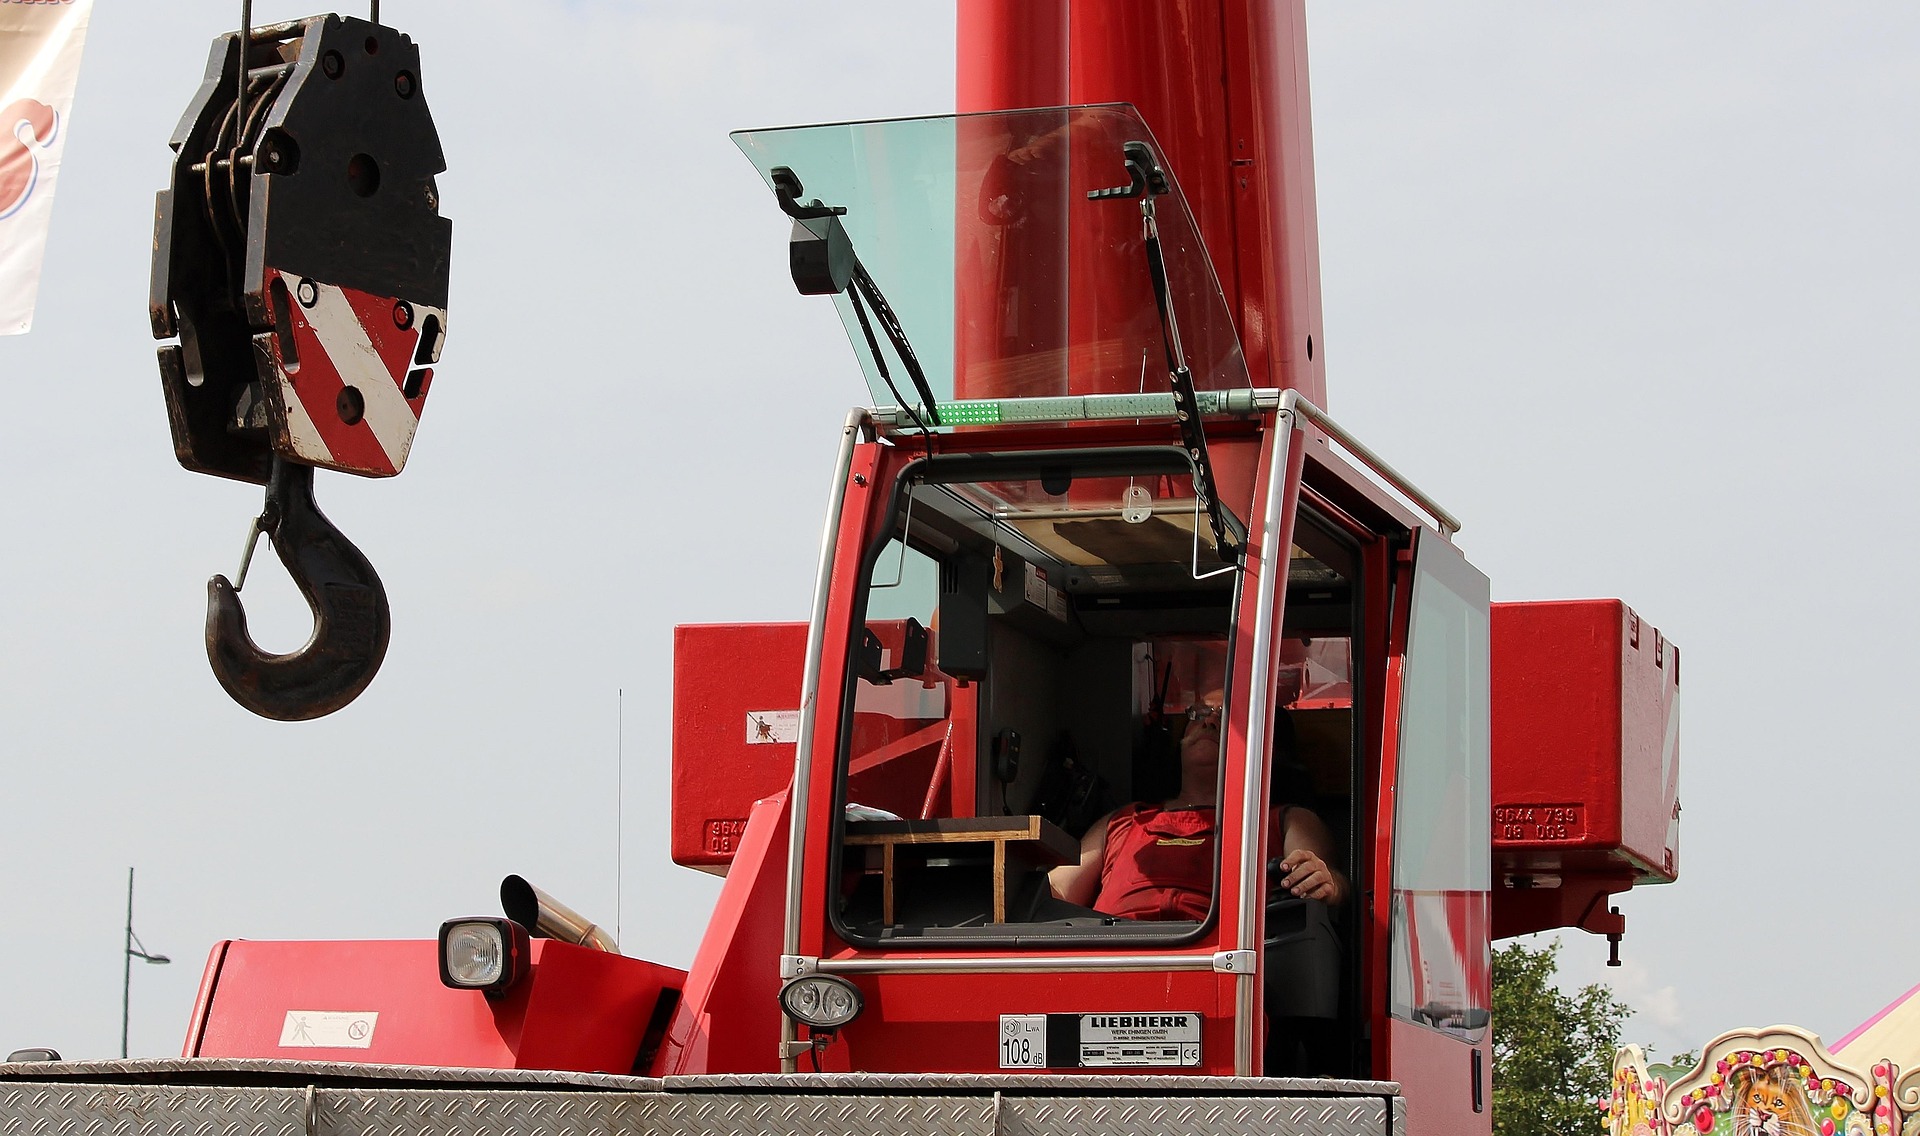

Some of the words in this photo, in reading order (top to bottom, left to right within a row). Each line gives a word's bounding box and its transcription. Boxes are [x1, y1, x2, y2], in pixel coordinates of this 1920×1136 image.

[1091, 1016, 1188, 1027] LIEBHERR
[1003, 1038, 1030, 1064] 108
[1033, 1053, 1043, 1064] dB
